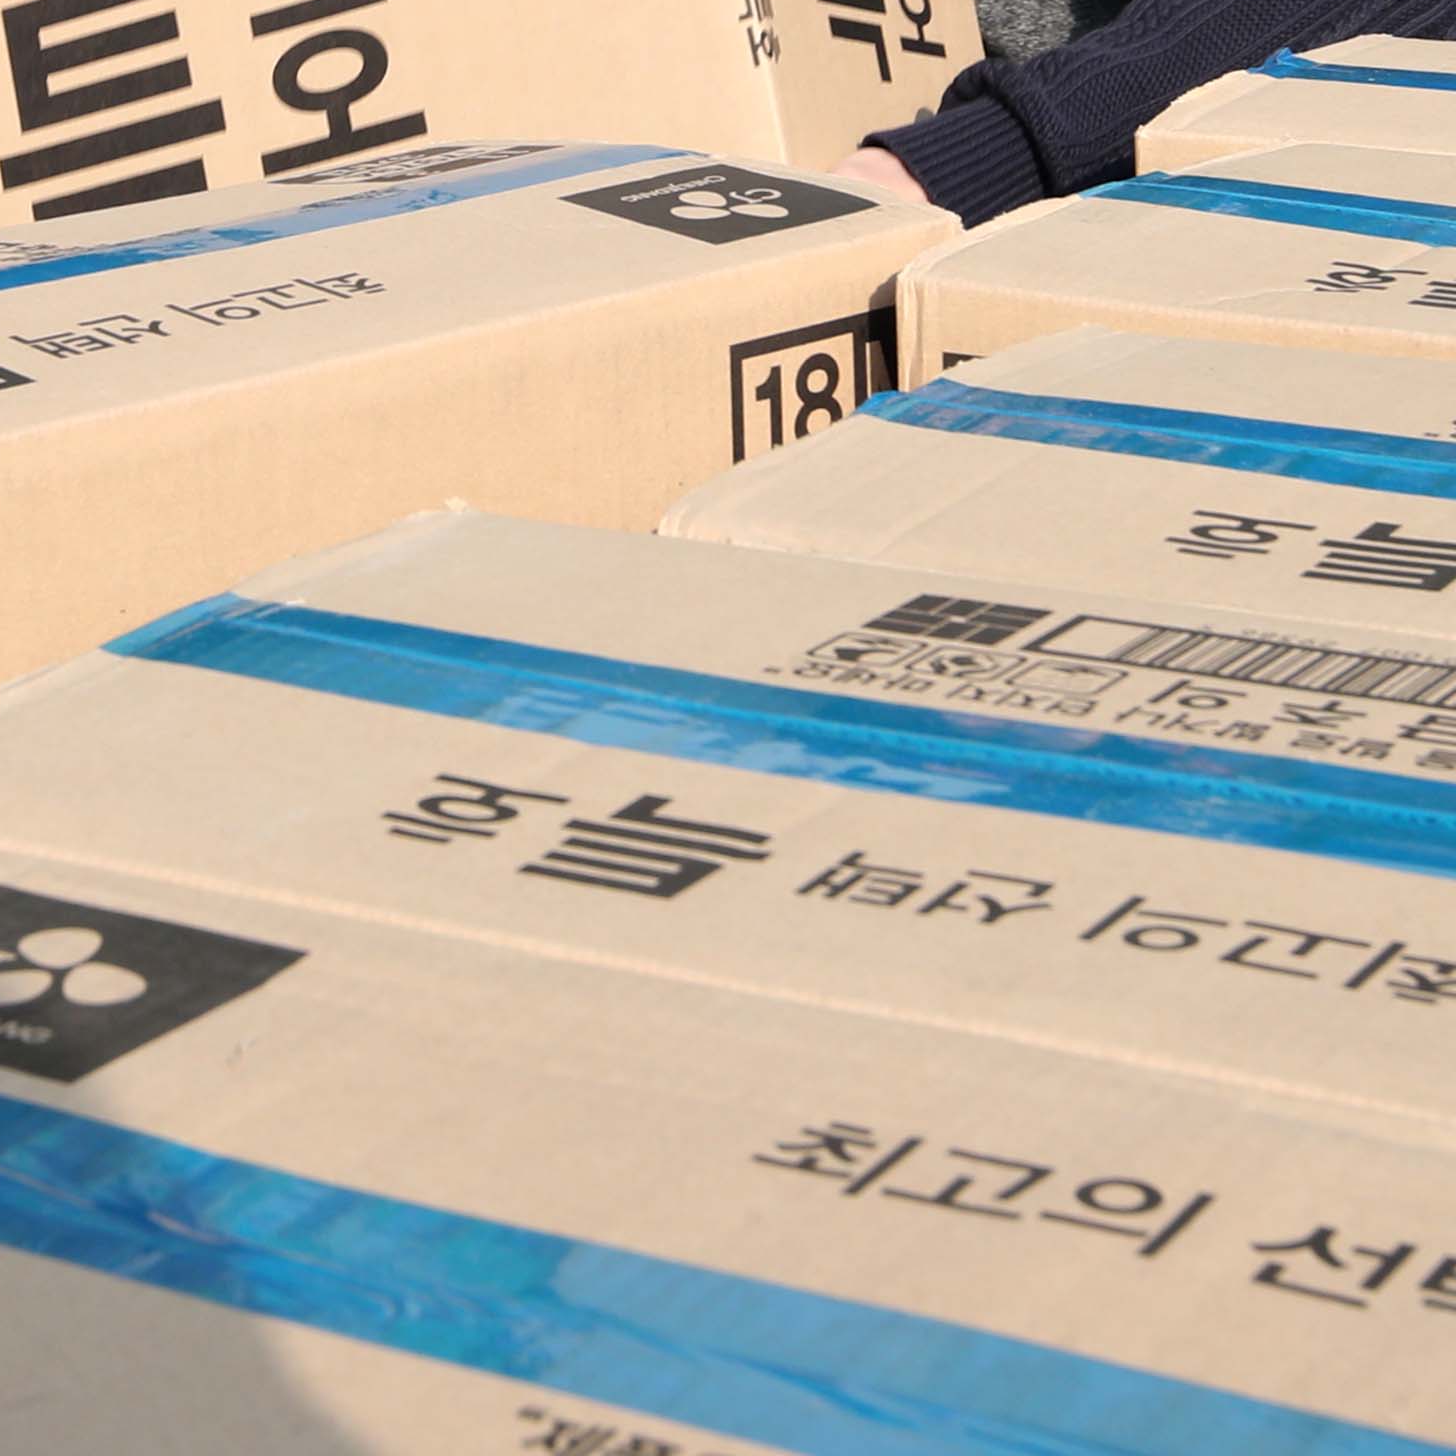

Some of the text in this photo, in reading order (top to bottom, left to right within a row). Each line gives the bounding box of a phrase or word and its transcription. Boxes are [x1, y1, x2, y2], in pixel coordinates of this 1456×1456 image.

[167, 272, 386, 326] 최고의
[9, 313, 171, 359] 선택
[382, 773, 773, 901] 특호
[795, 849, 1057, 921] 선택
[751, 1121, 1216, 1259] 최고의
